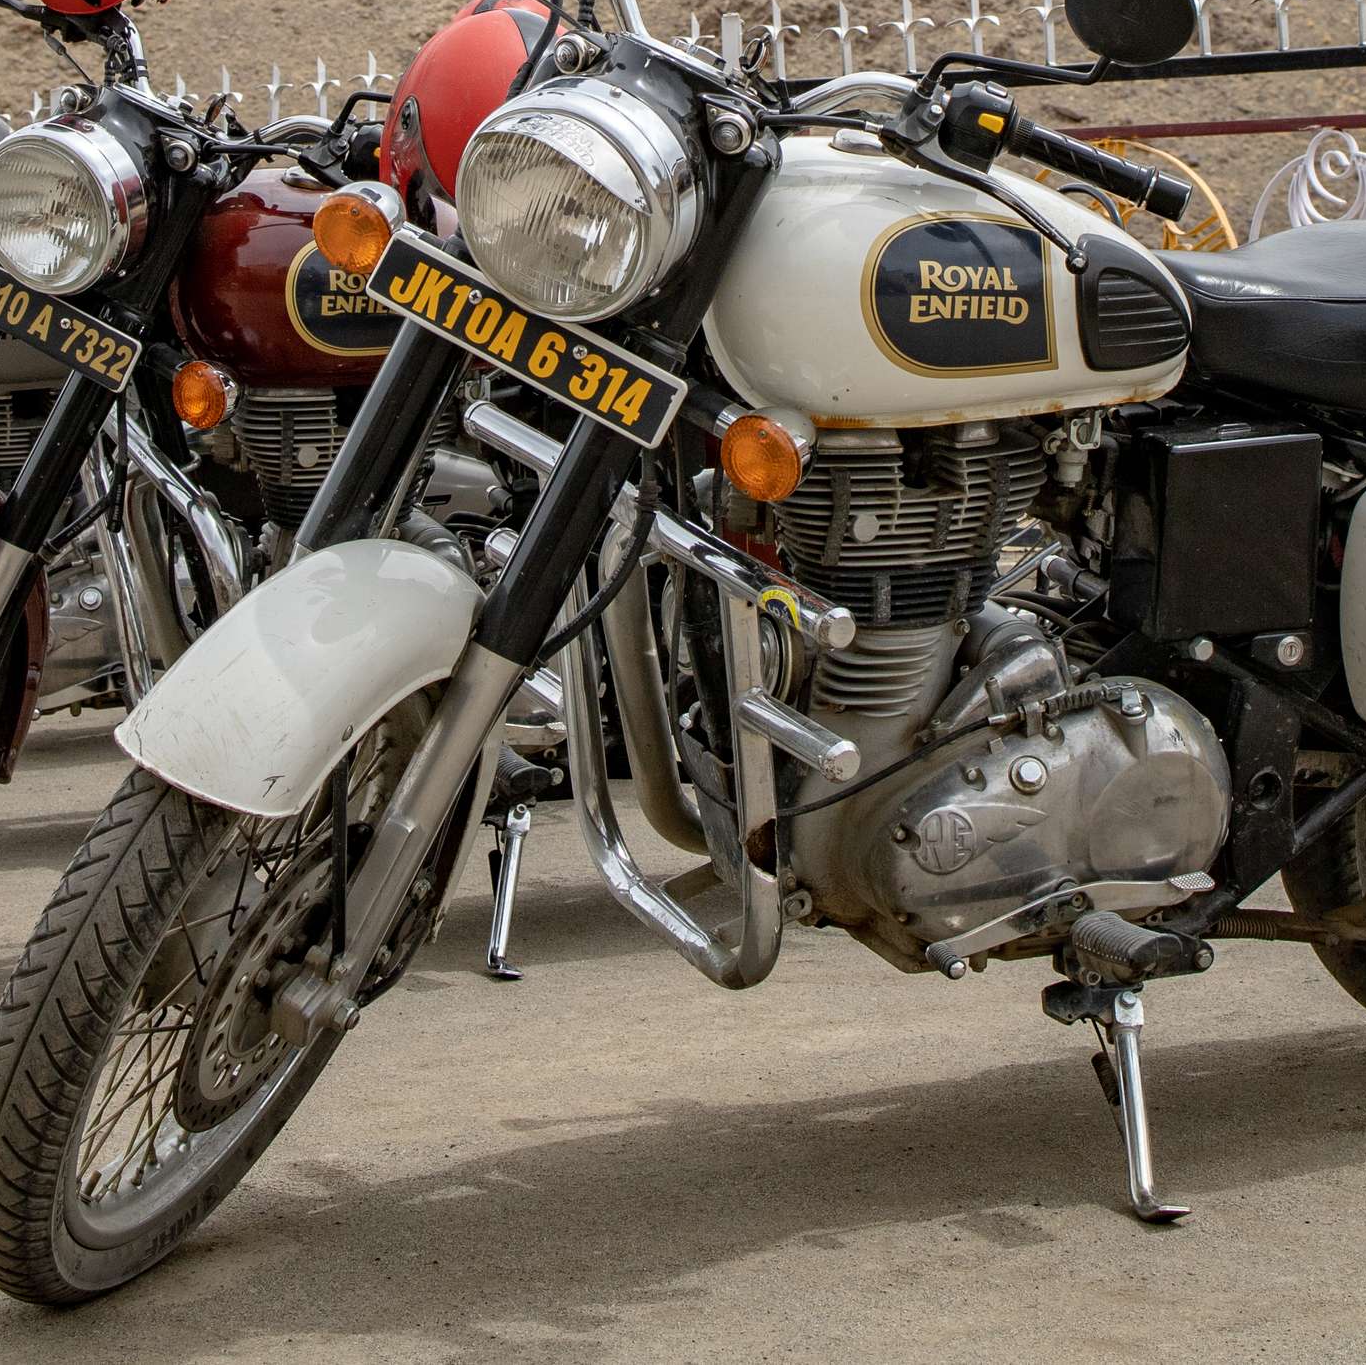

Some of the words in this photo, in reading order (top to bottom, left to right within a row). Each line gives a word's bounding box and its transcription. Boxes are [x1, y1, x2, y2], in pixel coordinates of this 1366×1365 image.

[919, 260, 1018, 293] ROYAL
[320, 295, 397, 317] ENFIE
[909, 294, 1029, 325] ENFIELD
[60, 319, 133, 382] 7322
